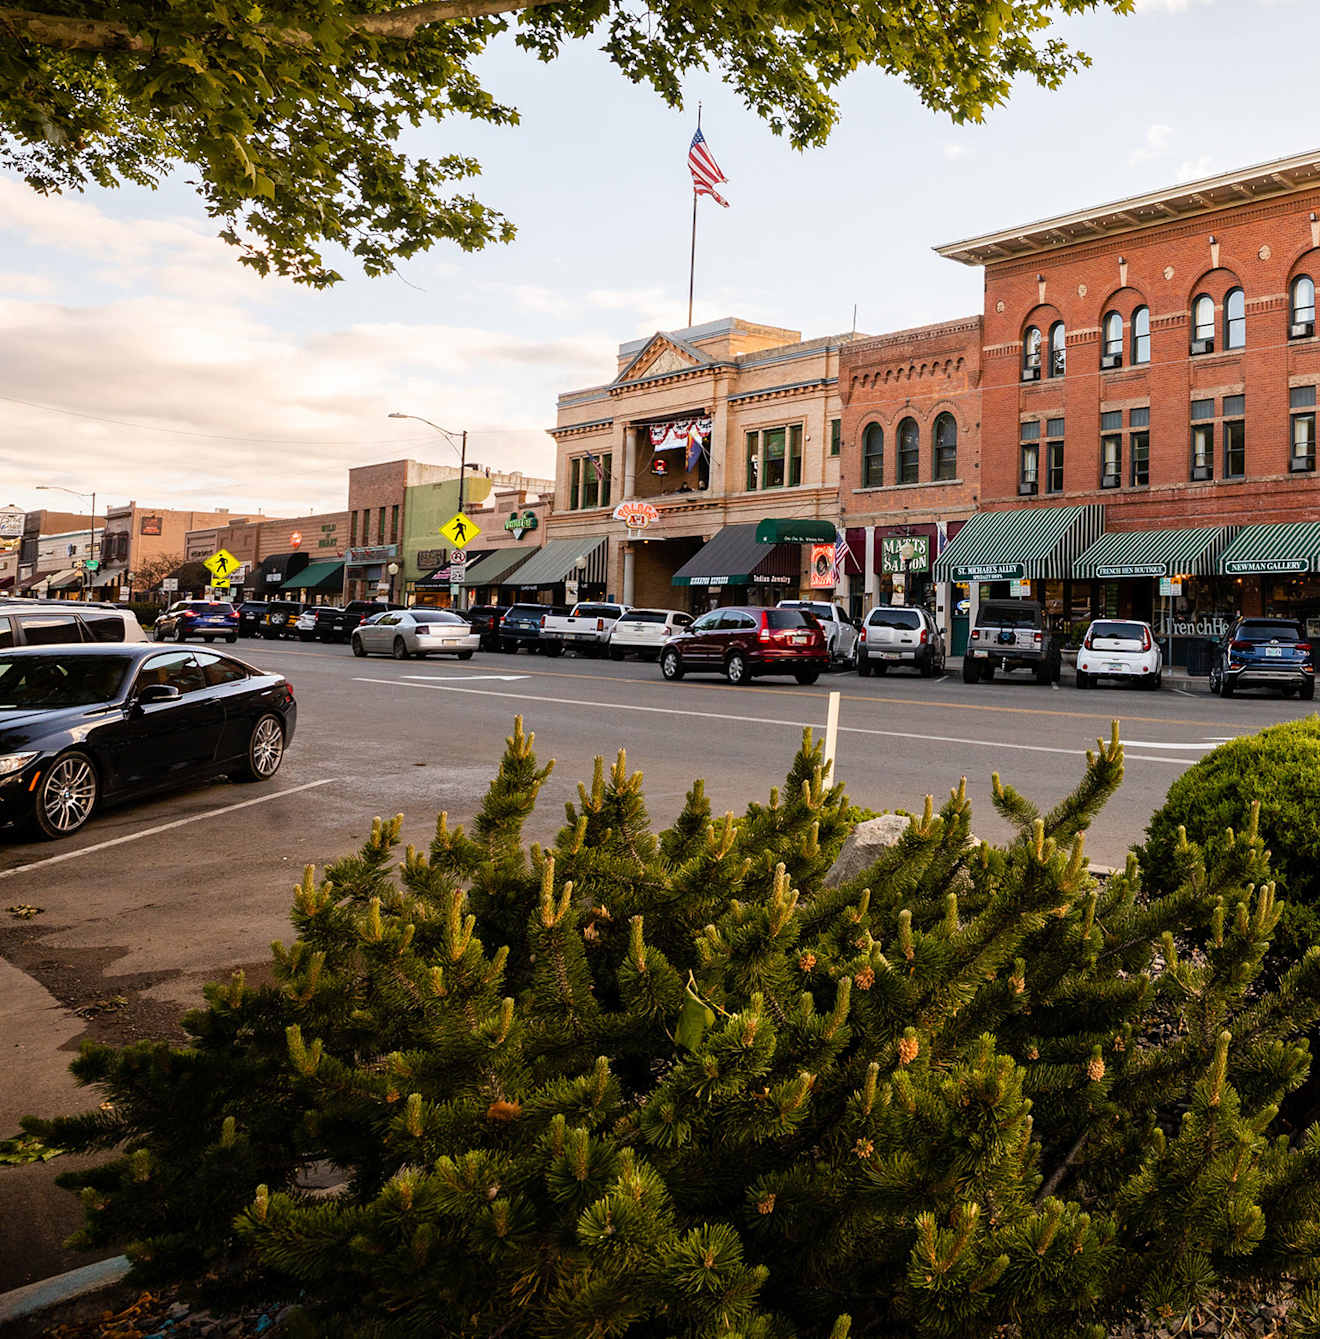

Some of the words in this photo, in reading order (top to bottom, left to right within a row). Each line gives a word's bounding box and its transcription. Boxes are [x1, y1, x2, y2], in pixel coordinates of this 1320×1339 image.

[884, 555, 926, 572] SALON
[1231, 563, 1267, 571] NEWMAN
[1267, 561, 1301, 570] GALLERY
[998, 565, 1017, 573] ALLEY
[1100, 567, 1121, 575] FRENCH
